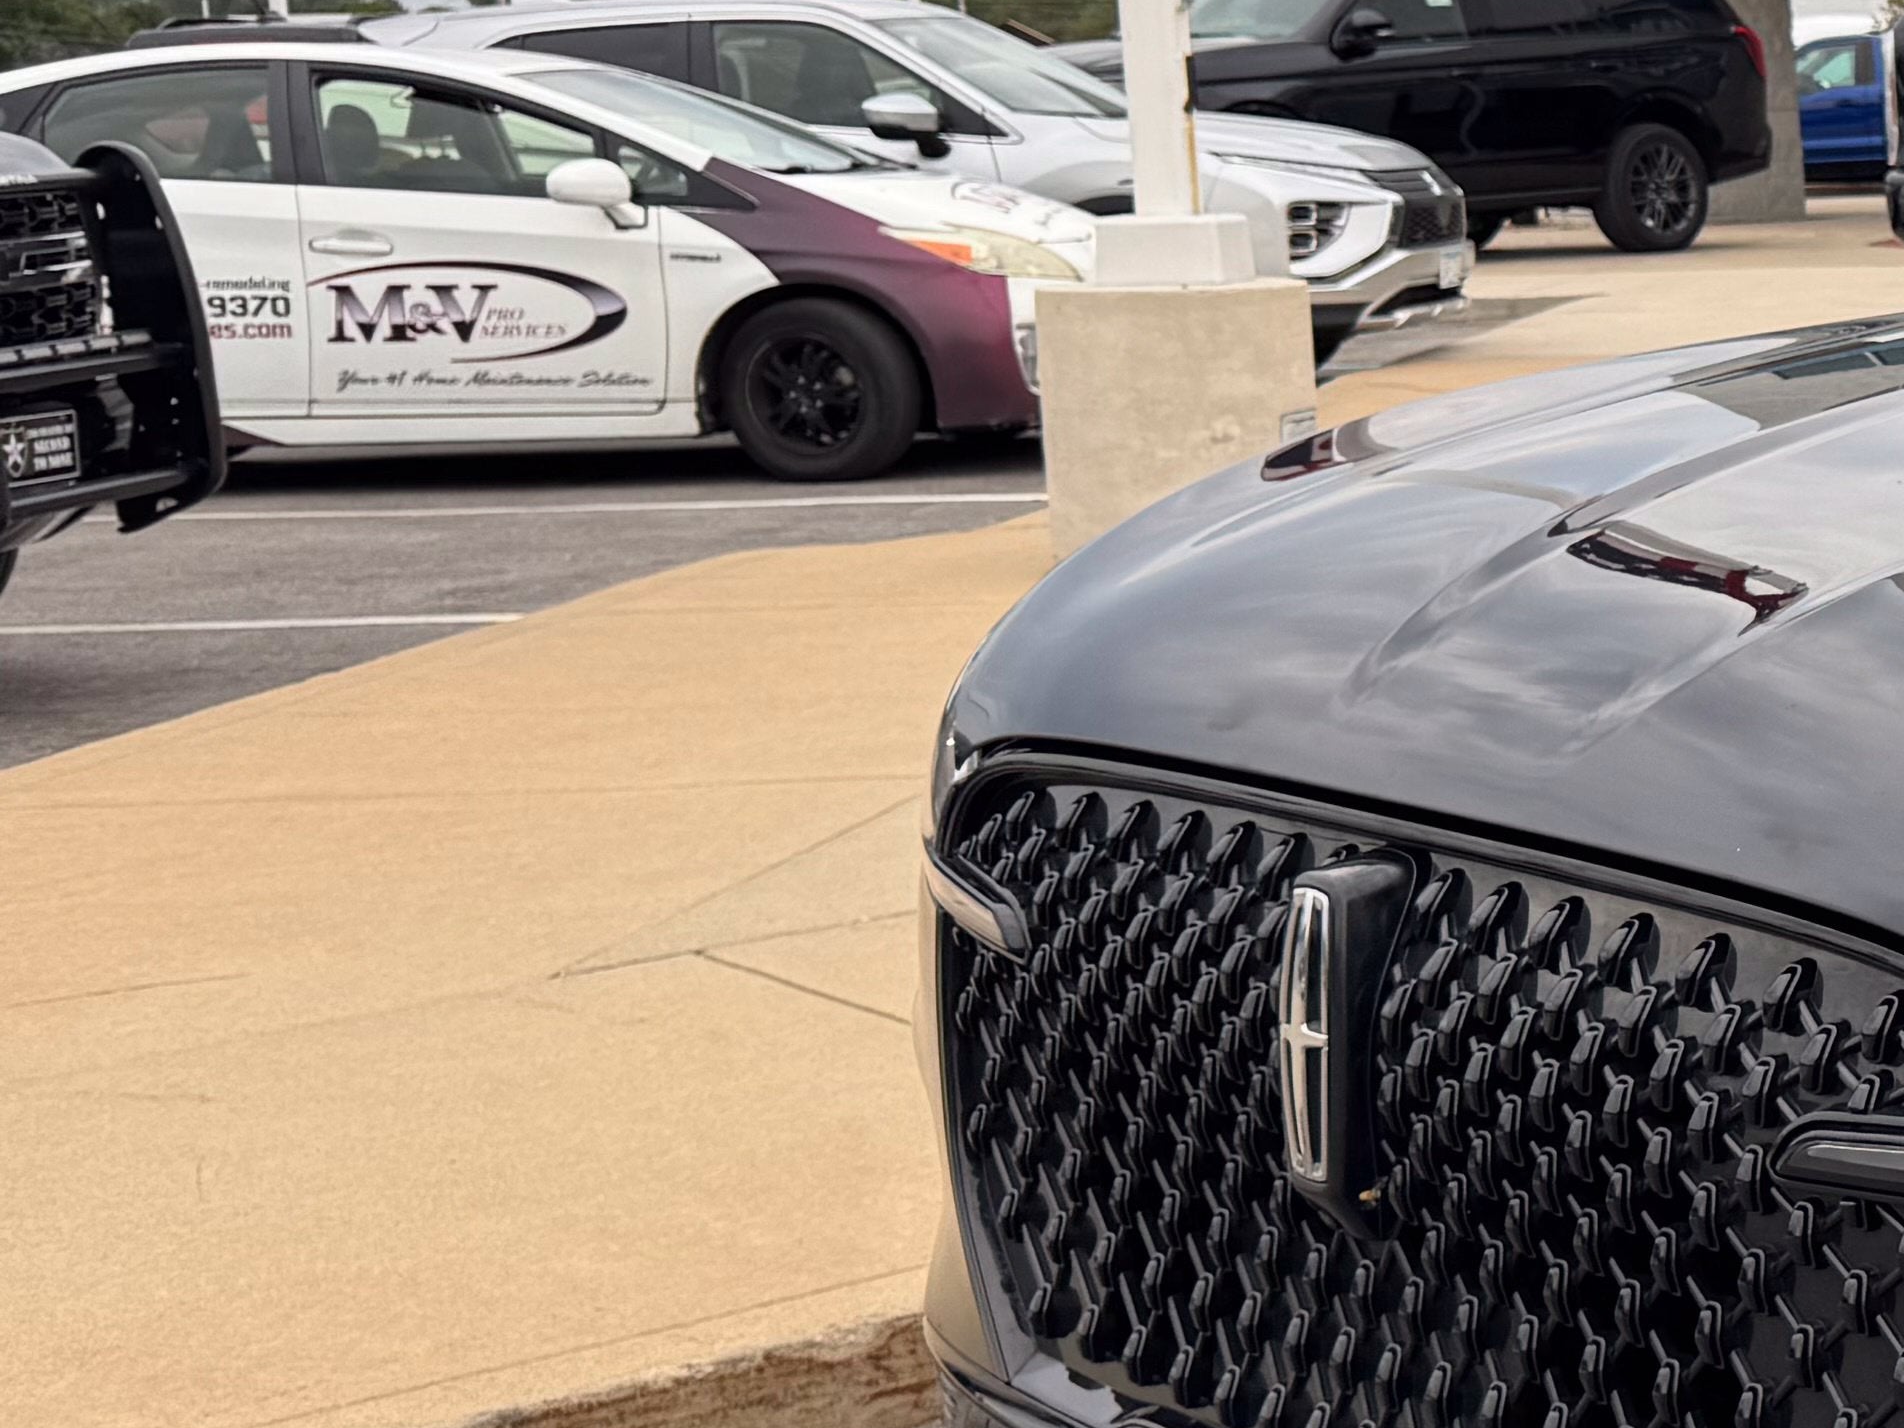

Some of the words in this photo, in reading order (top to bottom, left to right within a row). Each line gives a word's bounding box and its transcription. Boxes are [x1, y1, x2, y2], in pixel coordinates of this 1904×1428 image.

[207, 295, 291, 317] 9370
[326, 284, 497, 343] M&V
[486, 306, 525, 321] PRO
[480, 322, 567, 337] SERVICES
[412, 368, 461, 385] Home
